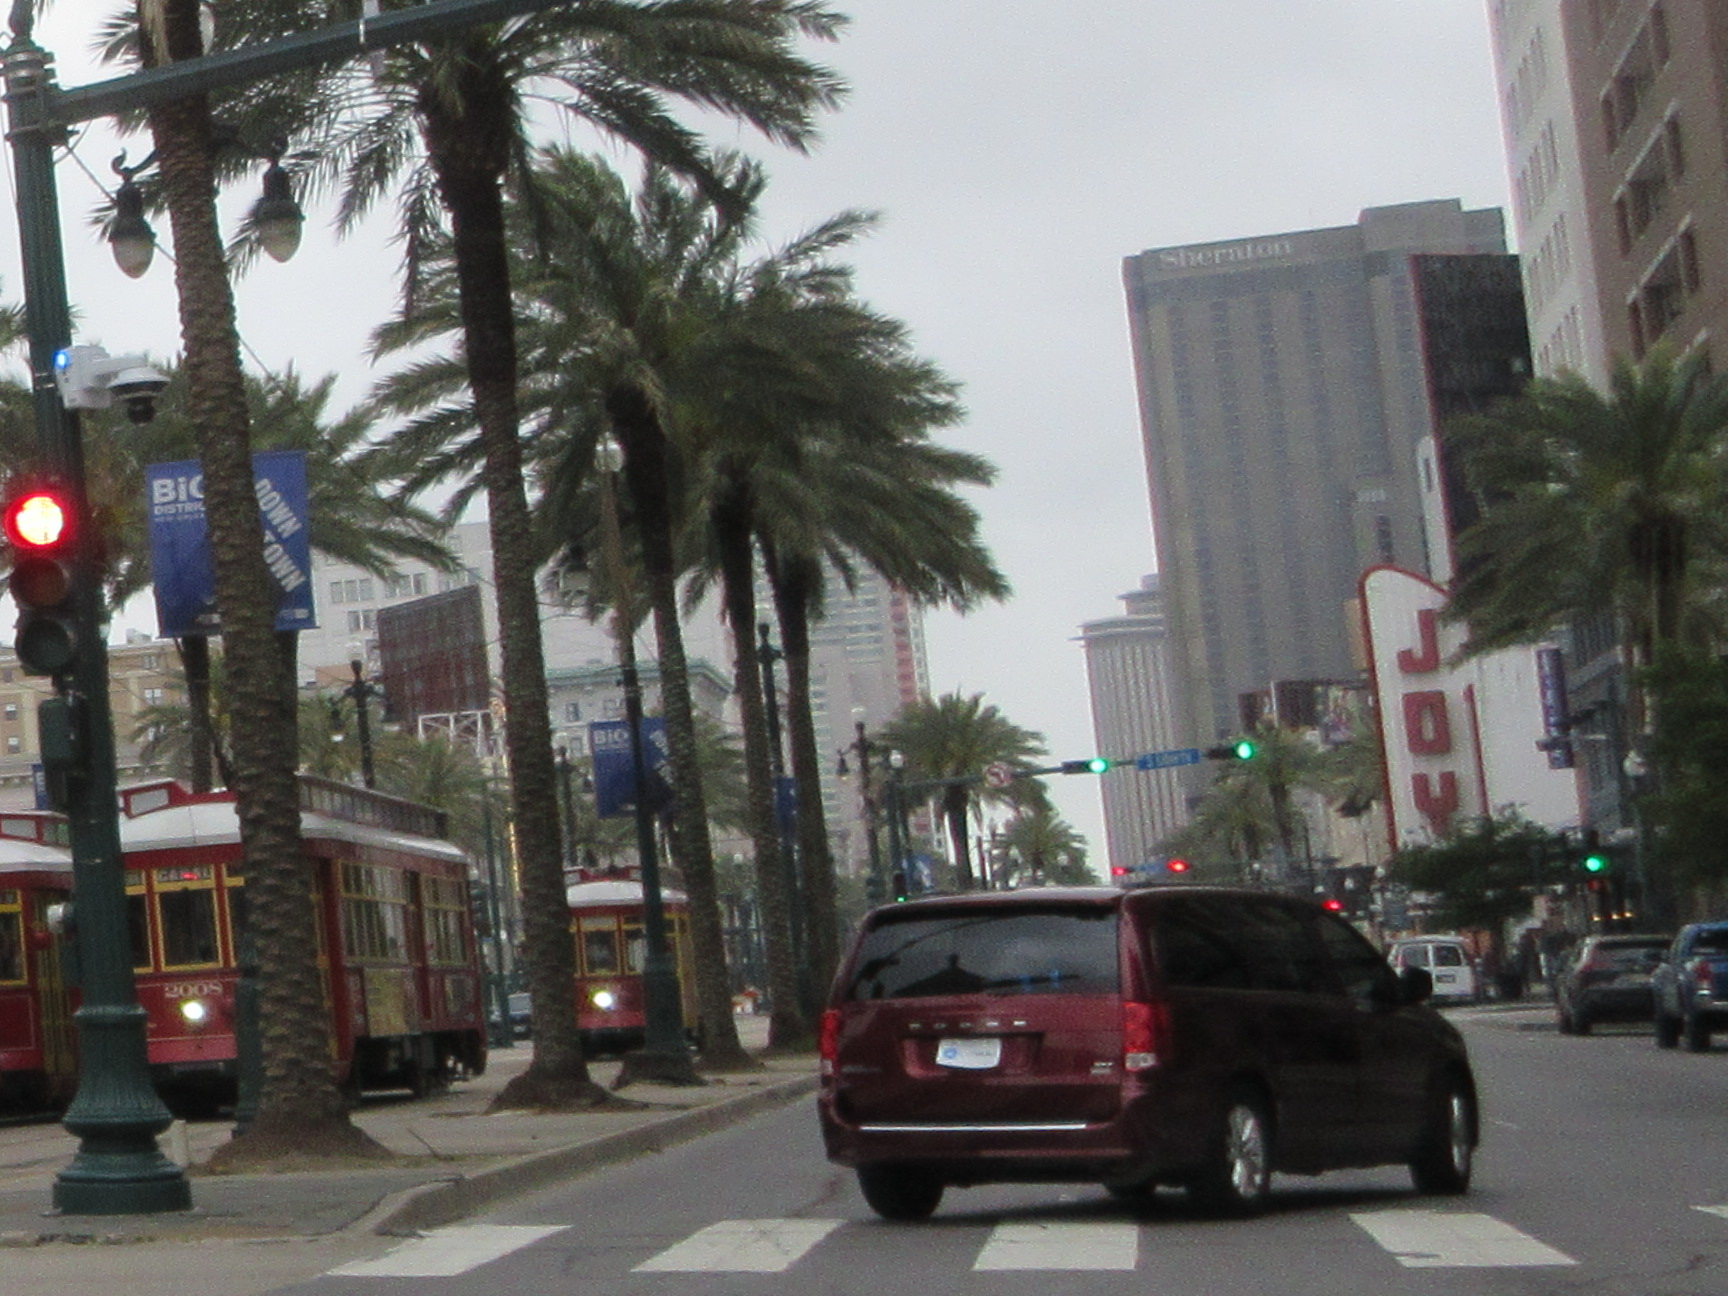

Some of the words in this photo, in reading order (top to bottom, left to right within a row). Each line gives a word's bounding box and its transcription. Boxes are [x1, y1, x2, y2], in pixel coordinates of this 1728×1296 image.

[1158, 238, 1293, 271] Sheraton
[255, 478, 303, 540] DOWN
[1397, 607, 1460, 838] JOY
